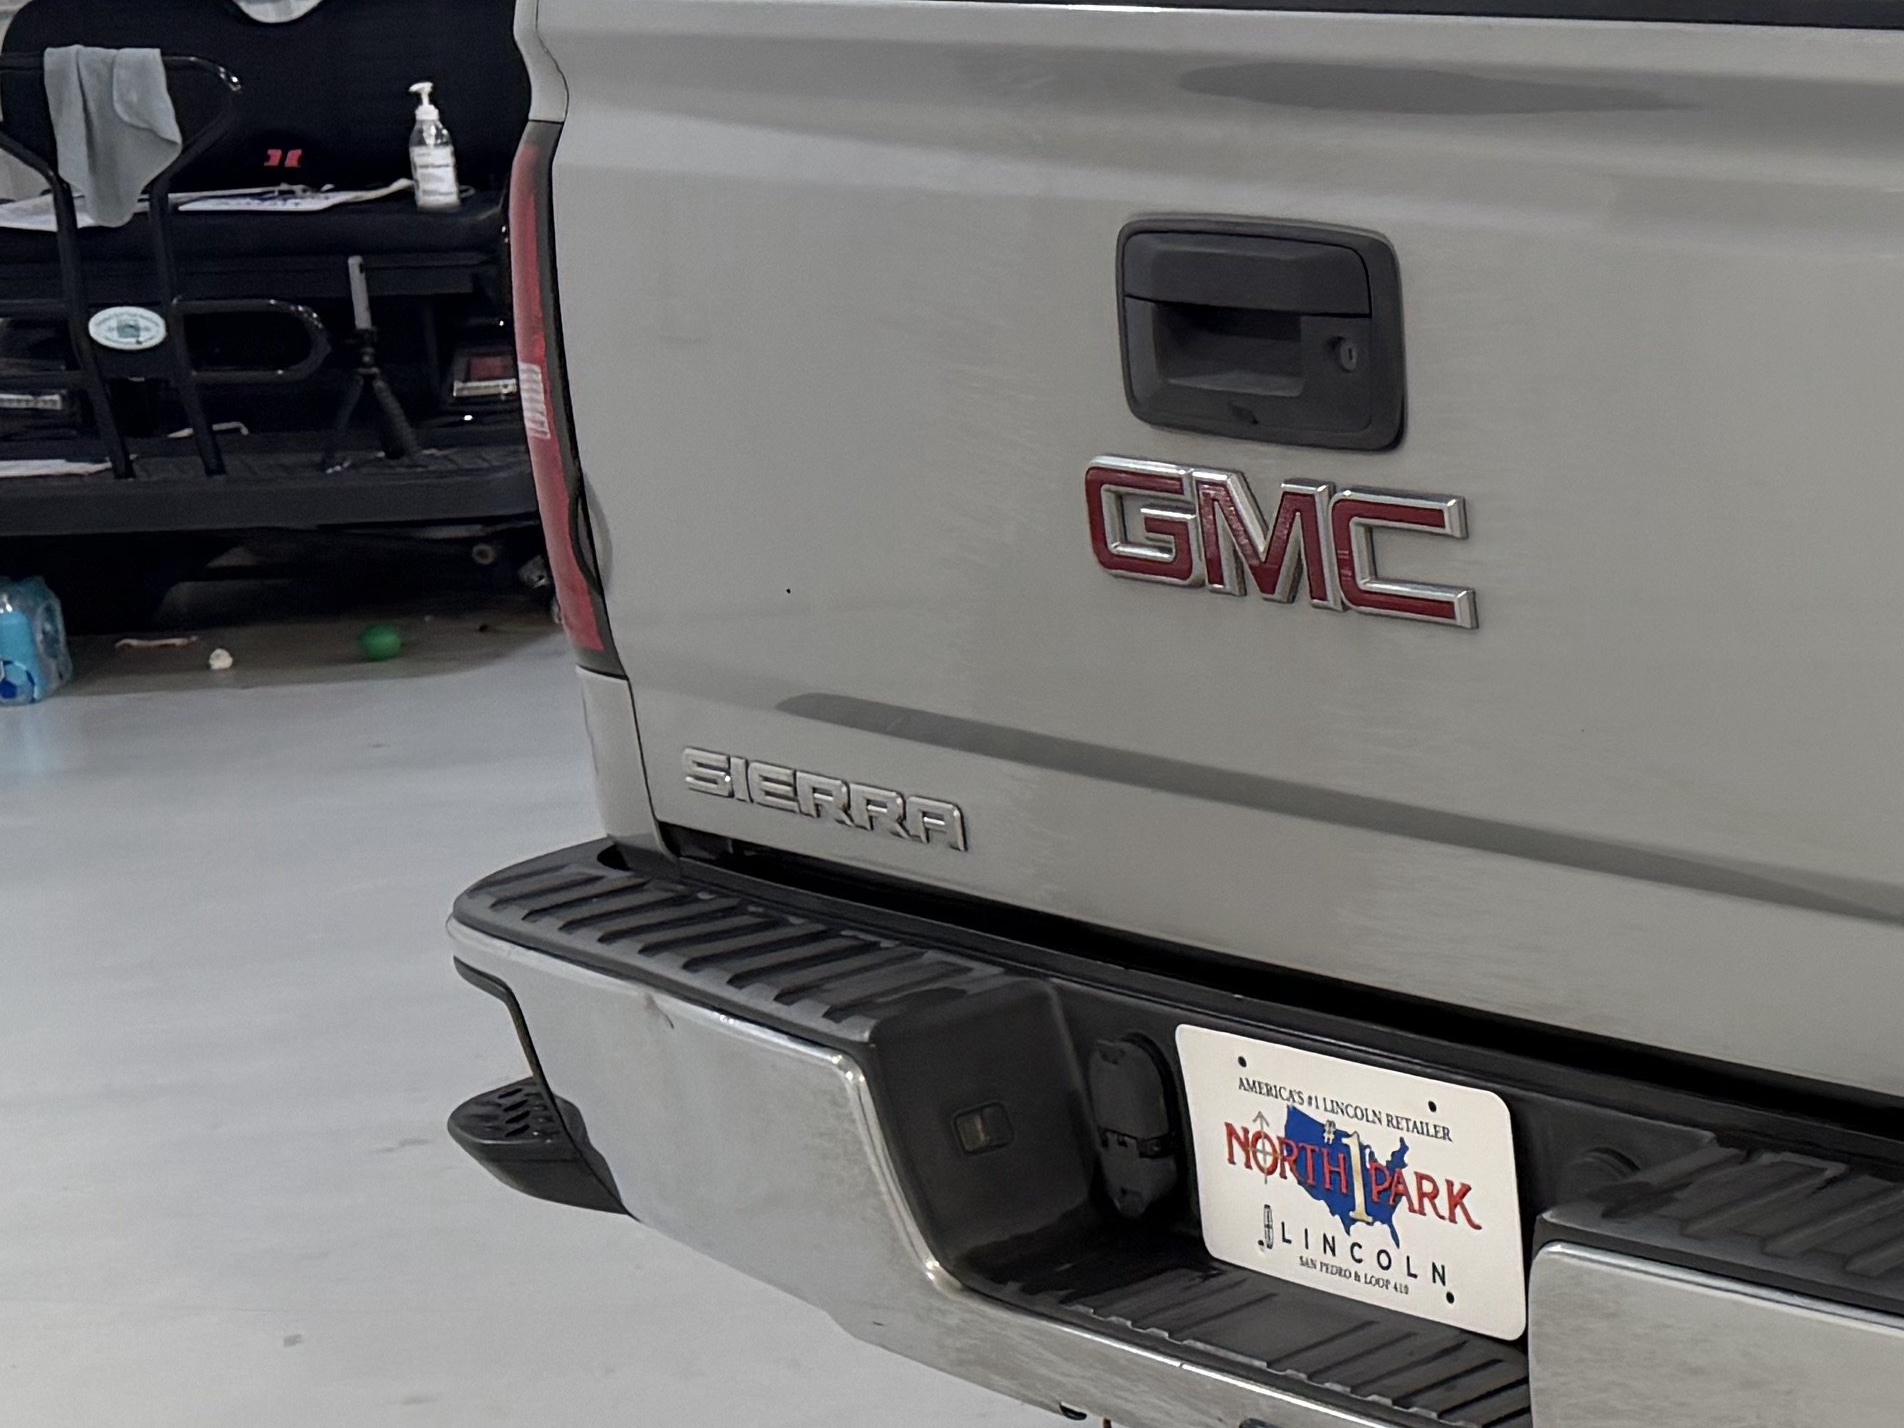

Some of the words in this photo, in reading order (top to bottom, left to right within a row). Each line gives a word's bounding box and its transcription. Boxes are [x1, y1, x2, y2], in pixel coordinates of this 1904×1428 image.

[1084, 453, 1480, 630] GMC
[683, 746, 968, 852] SIERRA
[1237, 1077, 1305, 1106] AMERICA'S
[1307, 1094, 1320, 1110] #1
[1322, 1096, 1383, 1125] LINCOLN
[1385, 1113, 1454, 1143] RETAILER
[1223, 1121, 1349, 1196] NORTH
[1368, 1161, 1483, 1231] PARK
[1280, 1220, 1447, 1287] LINCOLN
[1299, 1254, 1318, 1270] SAN
[1319, 1259, 1352, 1280] PEDRO
